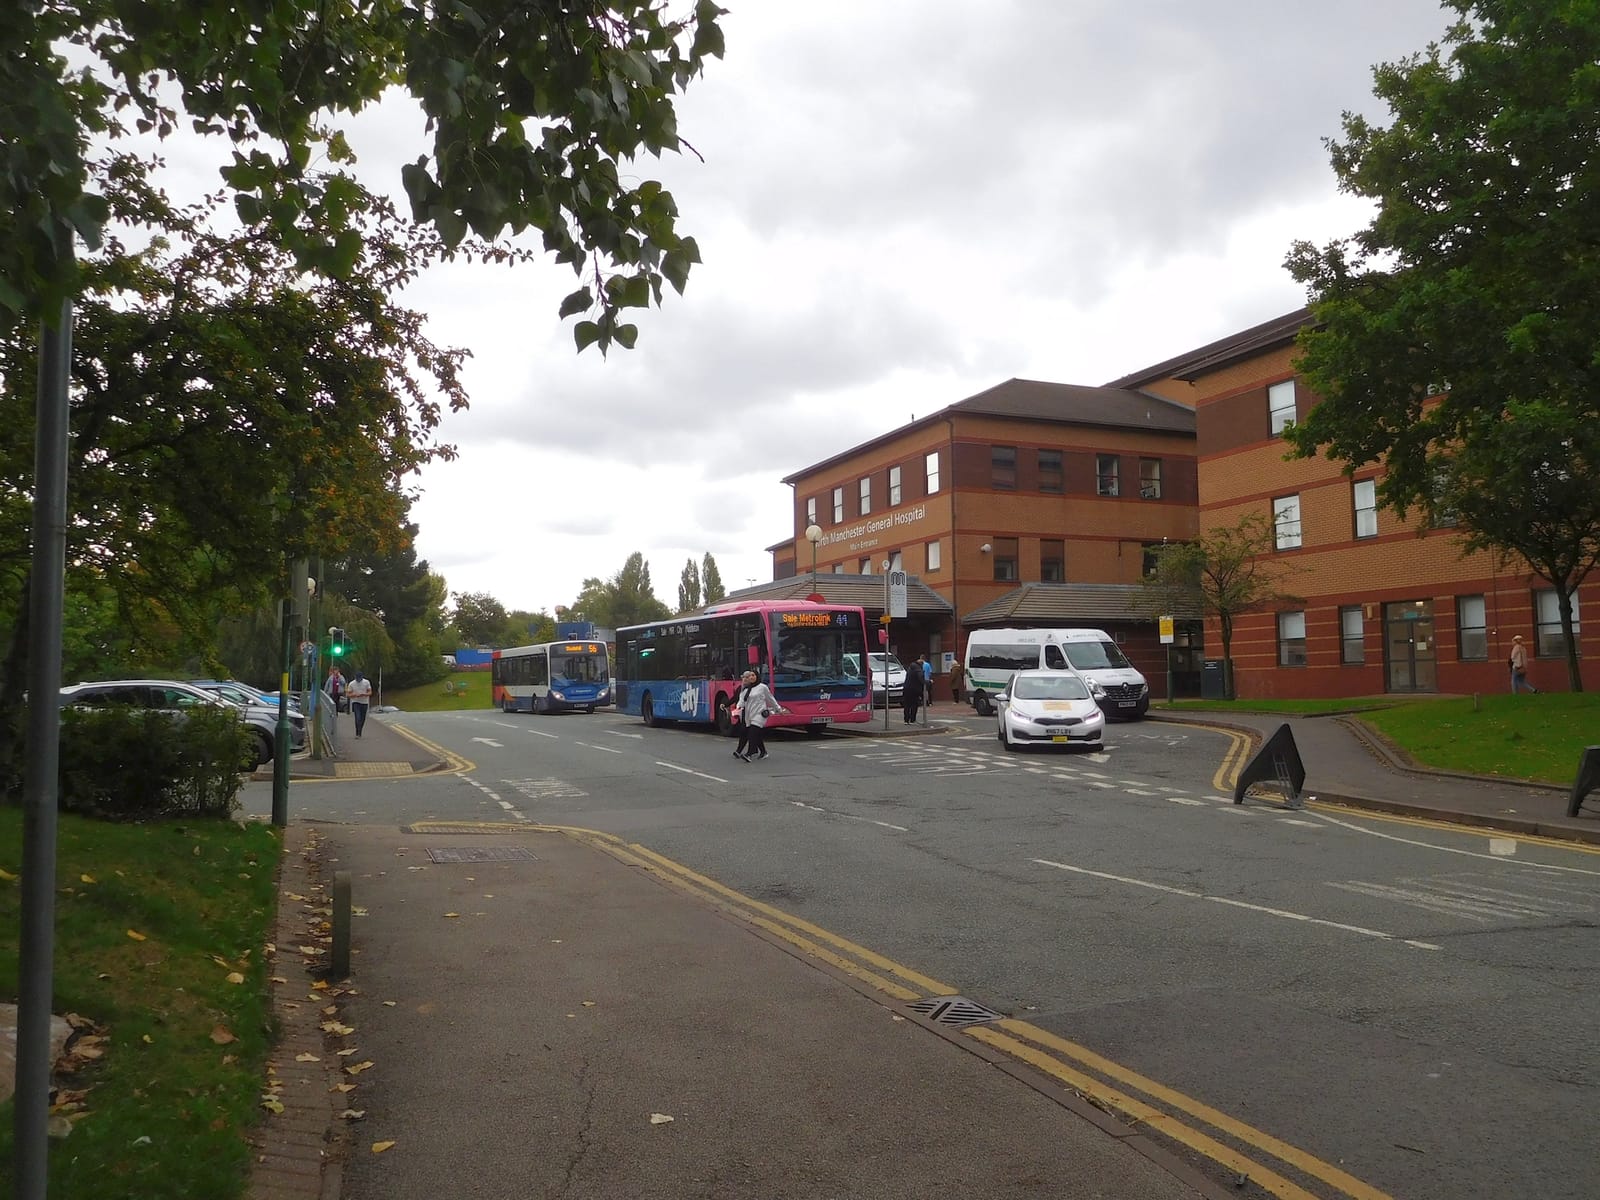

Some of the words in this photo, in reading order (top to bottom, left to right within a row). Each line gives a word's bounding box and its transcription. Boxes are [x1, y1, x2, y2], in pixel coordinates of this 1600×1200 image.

[830, 526, 865, 543] Manchester
[866, 514, 893, 533] General
[894, 503, 926, 526] Hospital
[860, 538, 878, 550] Entrance
[783, 613, 797, 623] Sale
[799, 613, 831, 623] Metrolink
[835, 614, 848, 626] 44
[680, 682, 699, 718] city
[820, 692, 831, 701] city
[851, 751, 1021, 777] ENTRY
